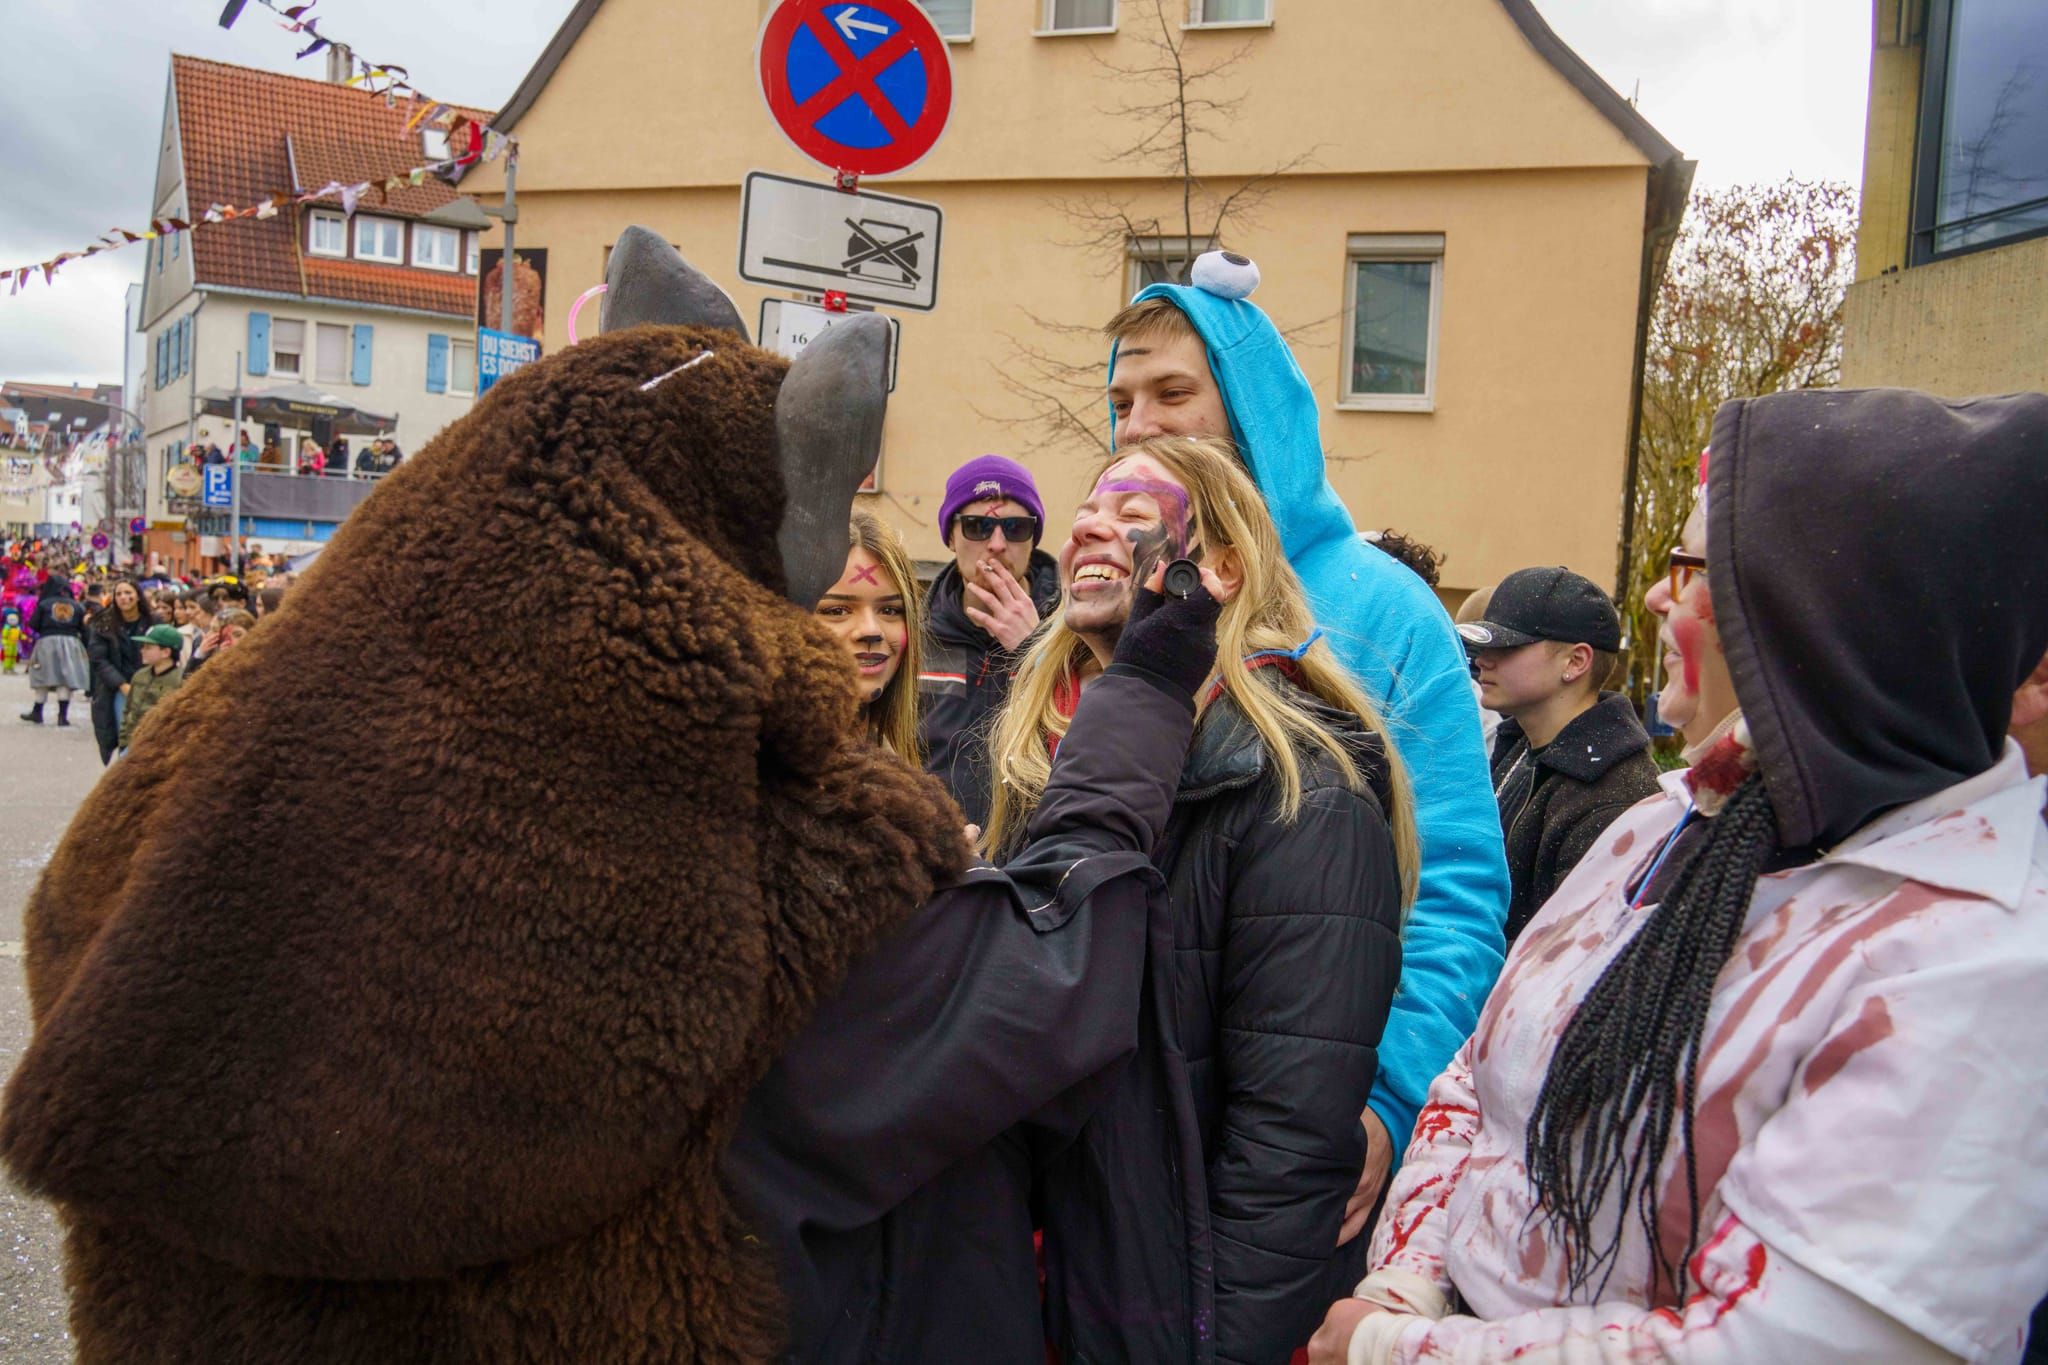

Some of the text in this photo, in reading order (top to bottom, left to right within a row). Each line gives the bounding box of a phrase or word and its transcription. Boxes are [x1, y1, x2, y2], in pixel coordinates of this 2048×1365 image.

[482, 334, 537, 361] DU SIEHST
[792, 333, 808, 345] 16
[482, 354, 497, 375] ES
[210, 466, 227, 493] P
